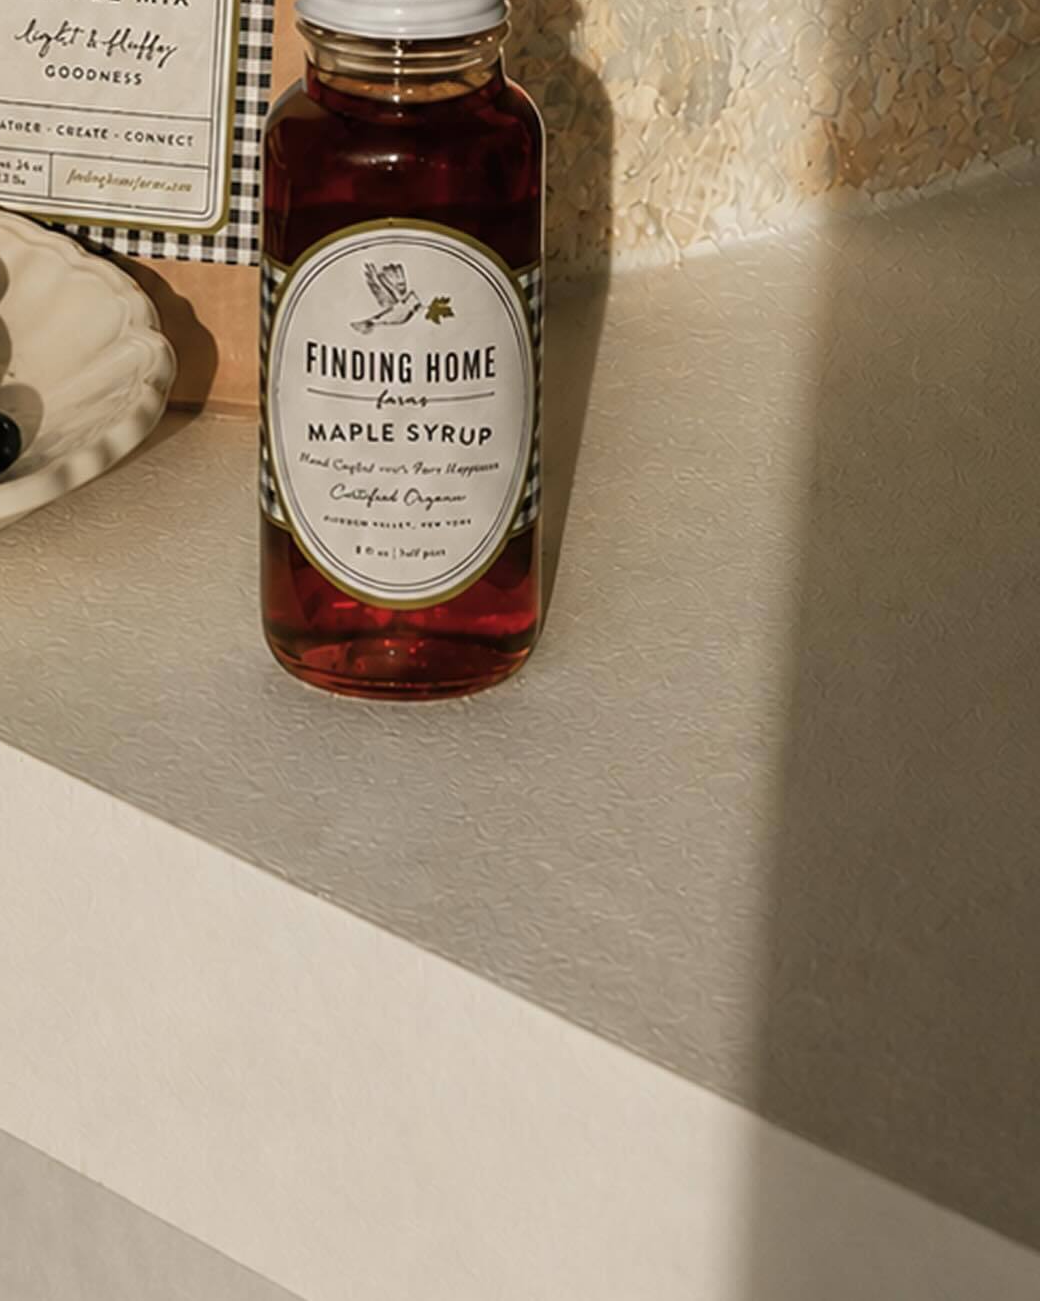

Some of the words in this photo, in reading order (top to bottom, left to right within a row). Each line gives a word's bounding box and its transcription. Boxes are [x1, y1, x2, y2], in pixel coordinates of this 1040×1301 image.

[15, 19, 84, 58] light
[101, 28, 178, 69] fluffy
[44, 64, 143, 86] GOODNESS
[56, 124, 110, 140] CREATE
[124, 130, 195, 147] CONNECT
[306, 341, 412, 384] FINDING
[426, 345, 496, 383] HOME
[376, 389, 428, 410] farms
[308, 423, 394, 442] MAPLE
[407, 423, 493, 446] SYRUP
